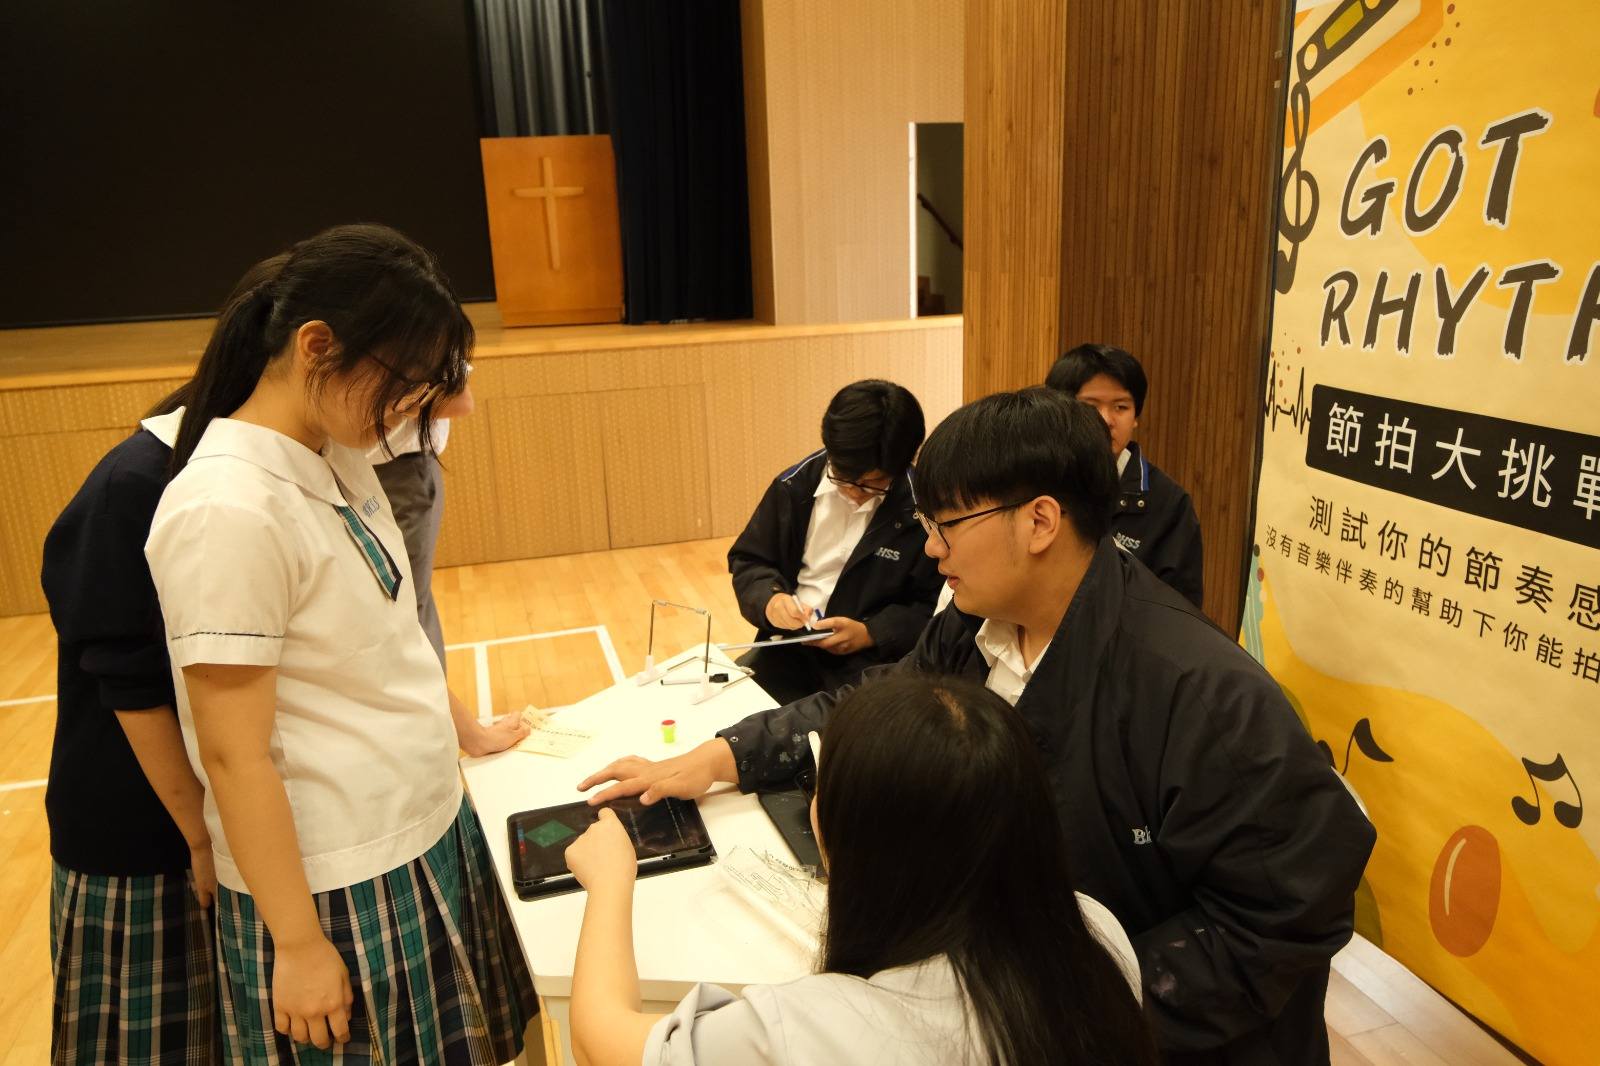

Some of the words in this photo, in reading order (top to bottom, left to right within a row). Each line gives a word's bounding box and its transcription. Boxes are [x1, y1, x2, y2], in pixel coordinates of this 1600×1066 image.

[1340, 112, 1549, 236] GOT
[875, 547, 900, 560] HSS
[1309, 495, 1600, 632] 測試你的節奏感
